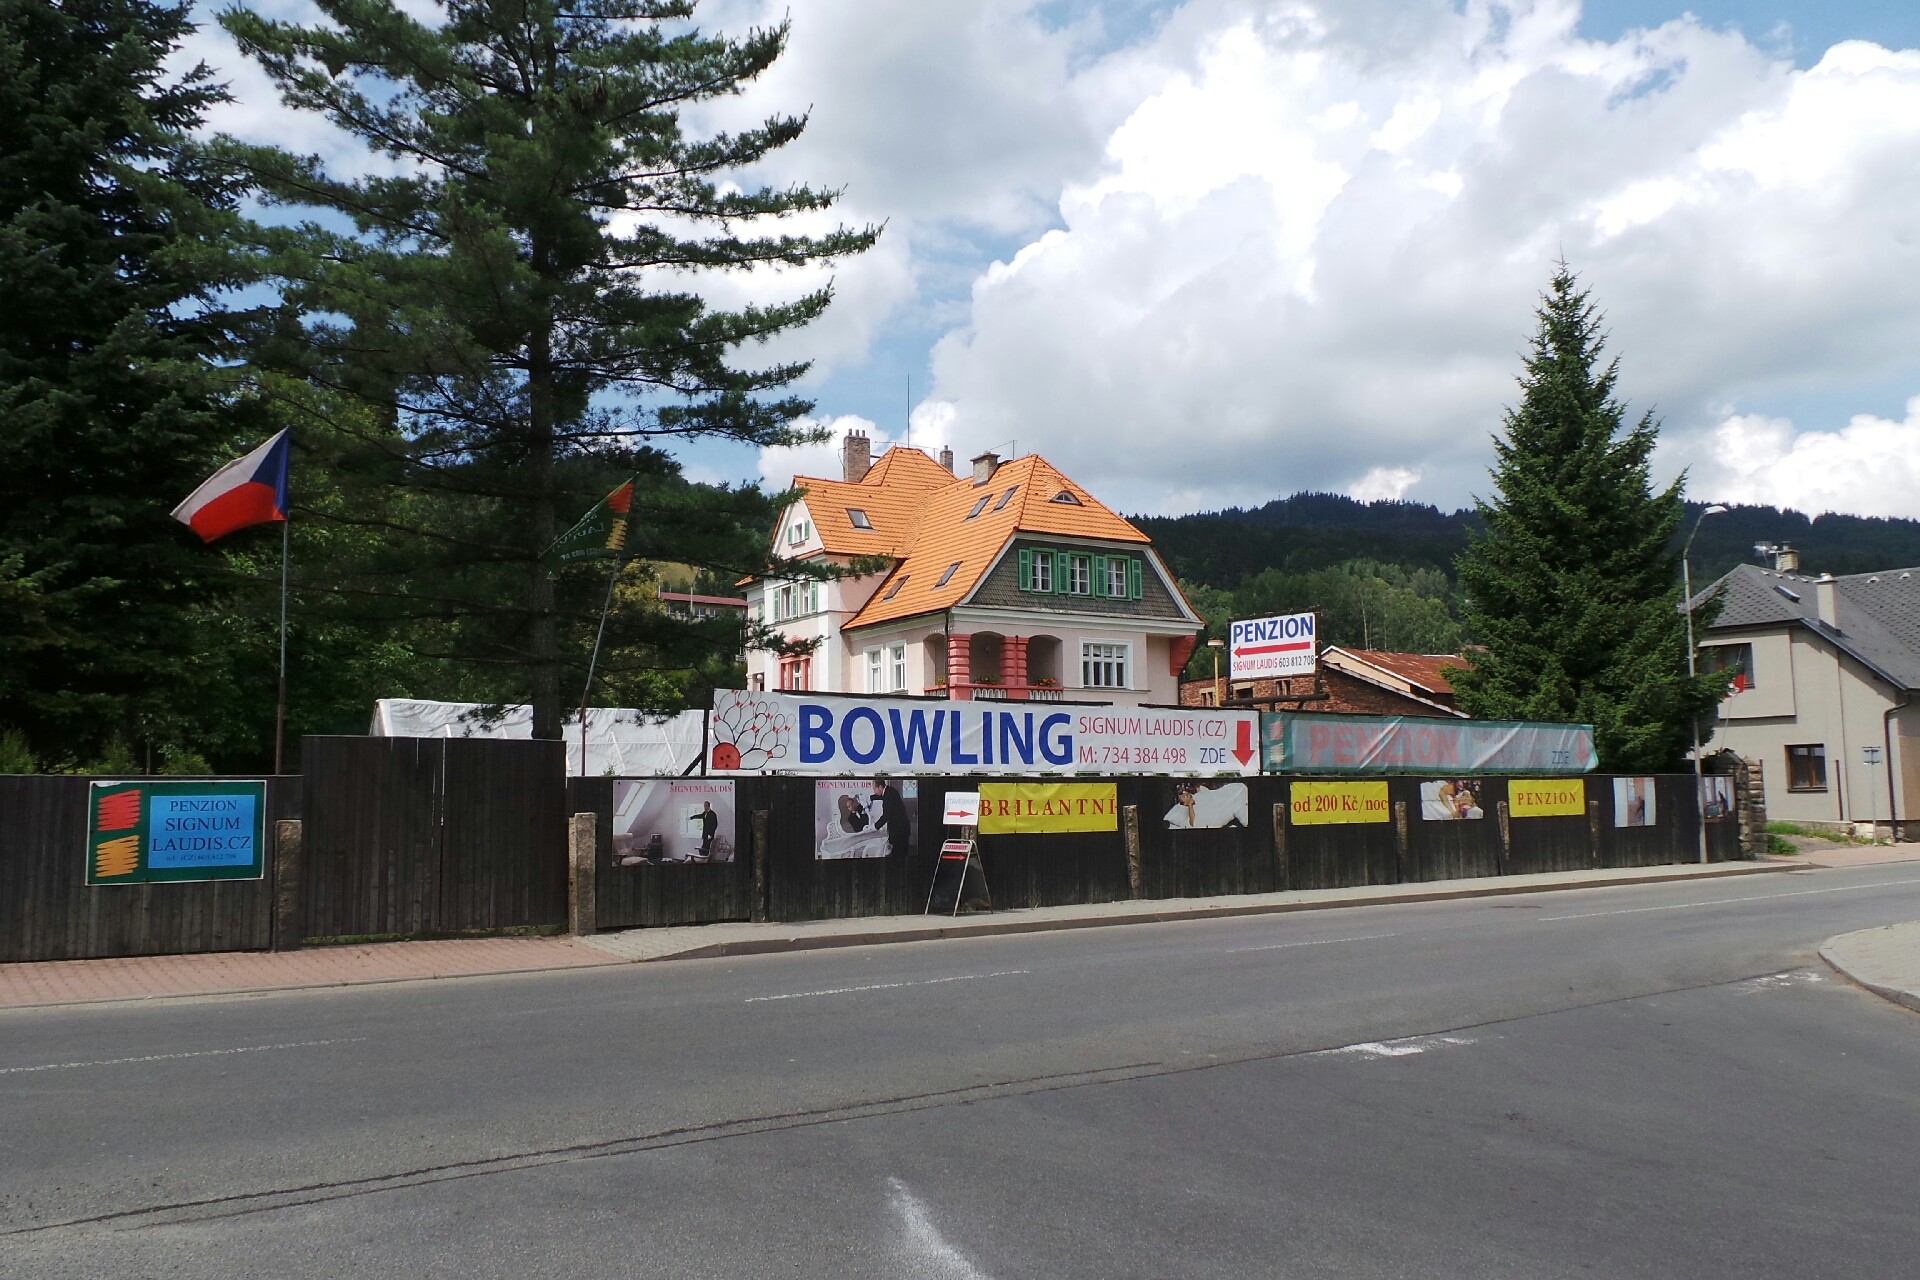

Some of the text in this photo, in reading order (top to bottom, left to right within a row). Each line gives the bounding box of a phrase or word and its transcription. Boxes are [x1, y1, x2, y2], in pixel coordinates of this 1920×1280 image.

[1233, 615, 1314, 644] PENZION
[1233, 654, 1315, 672] SIGNUM LAUDIS 603 812 708
[798, 704, 1074, 765] BOWLING
[1079, 715, 1227, 739] SIGNUM LAUDIS (.CZ)
[1309, 724, 1459, 765] PENZION
[1079, 745, 1227, 764] M: 734 384 498 ZDE
[1551, 750, 1570, 765] ZDE
[670, 785, 732, 793] SIGNUM LAUDIS
[1517, 790, 1577, 806] PENZION
[170, 799, 237, 812] PENZION
[979, 793, 1117, 817] BRILANTNÍ
[1293, 794, 1388, 813] od 200 Kč/noc
[165, 817, 240, 832] SIGNUM
[152, 836, 251, 852] LAUDIS.CZ
